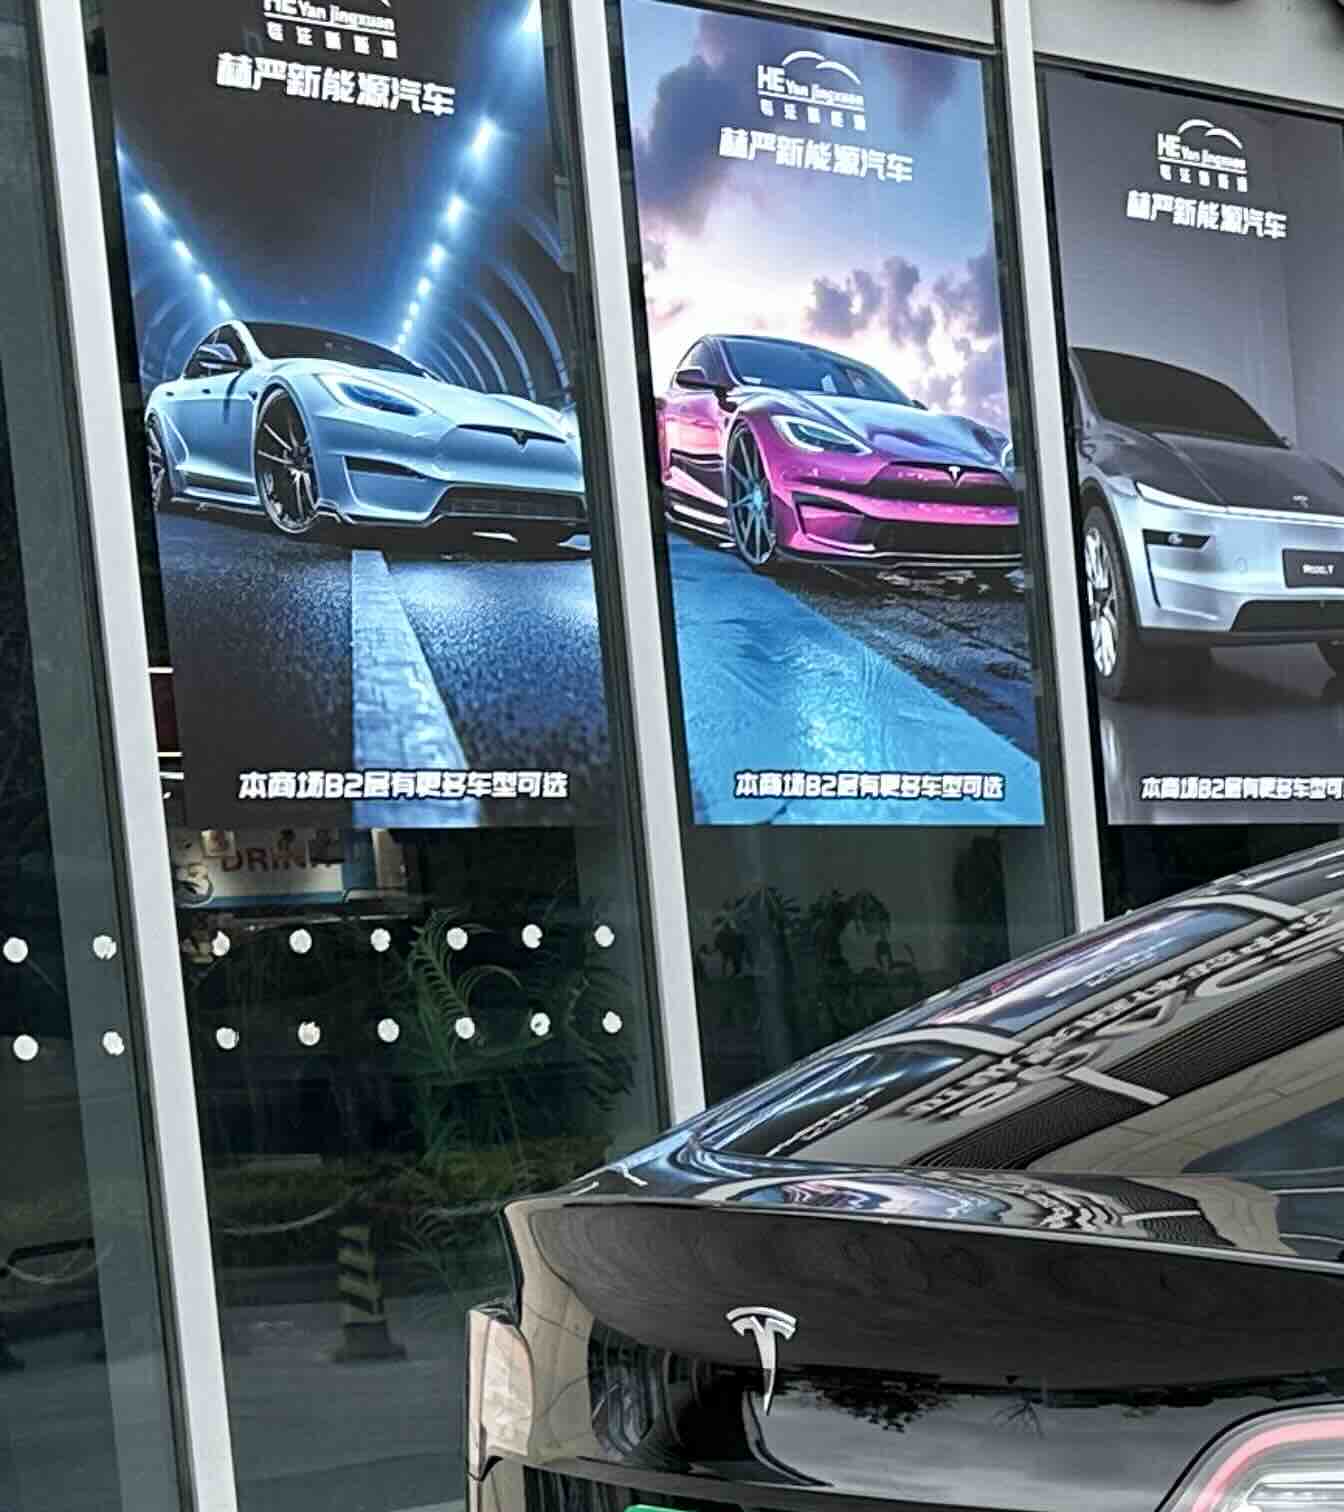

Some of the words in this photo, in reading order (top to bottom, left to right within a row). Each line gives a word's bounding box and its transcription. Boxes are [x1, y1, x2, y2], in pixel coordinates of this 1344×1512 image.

[238, 770, 569, 799] 本商场B2层有更多车型可选
